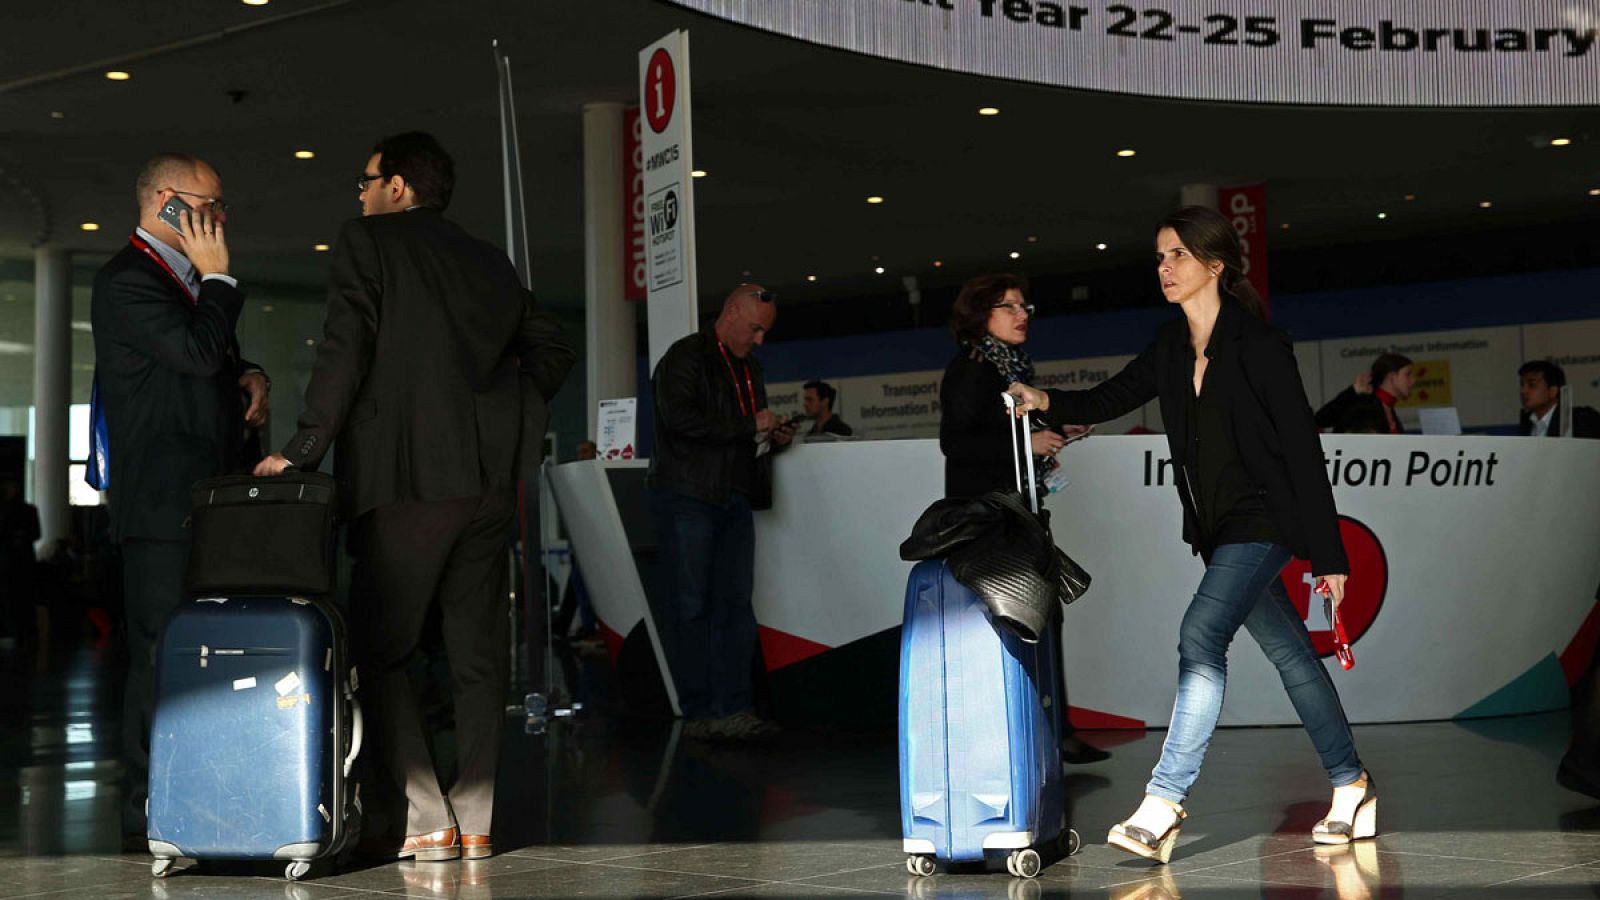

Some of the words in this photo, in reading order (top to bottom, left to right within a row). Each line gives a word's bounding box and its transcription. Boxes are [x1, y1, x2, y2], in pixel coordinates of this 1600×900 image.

[1106, 4, 1280, 48] 22-25
[1300, 18, 1596, 57] February
[1427, 339, 1489, 352] Information
[1080, 369, 1108, 382] Pass
[882, 381, 937, 398] Transport
[861, 402, 929, 420] Information
[1406, 450, 1499, 487] Point
